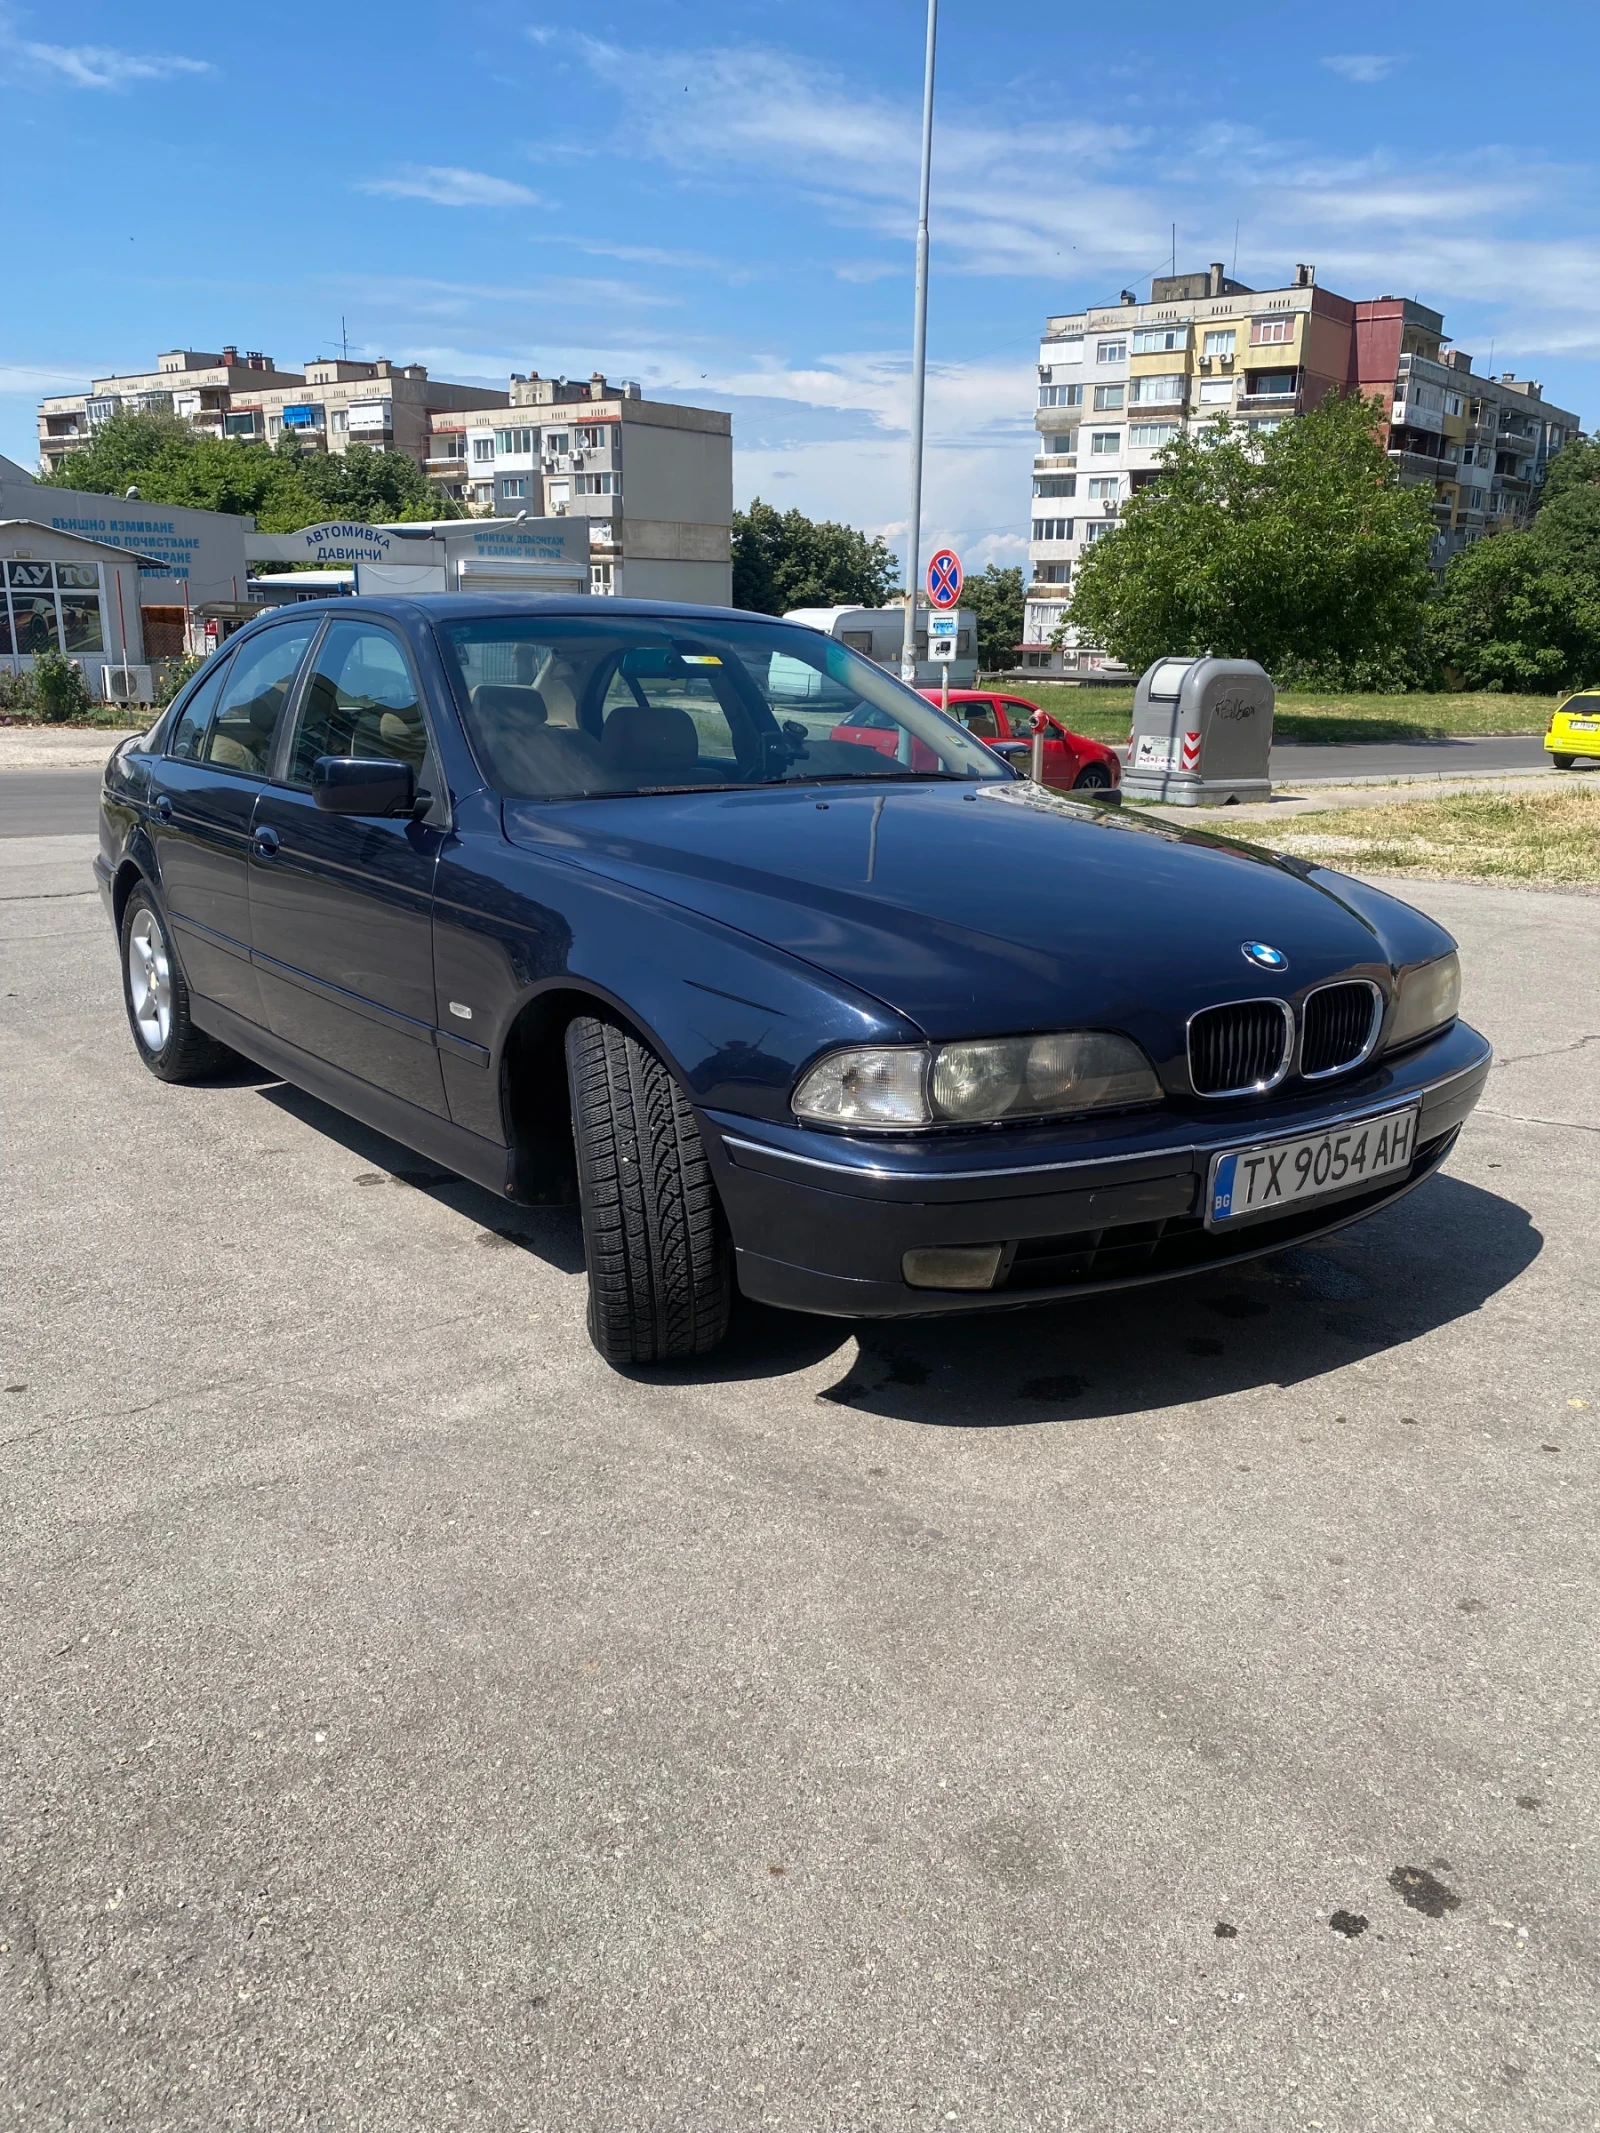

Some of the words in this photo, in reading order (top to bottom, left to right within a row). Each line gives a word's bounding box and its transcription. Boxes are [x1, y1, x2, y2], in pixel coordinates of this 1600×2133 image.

[52, 517, 106, 531] ВЪНШНО
[110, 520, 175, 534] ИЗМИВАНЕ
[124, 536, 200, 549] ПОЧИСТВАНЕ
[305, 525, 390, 549] АВТОМИВКА
[474, 533, 514, 544] МОНТАЖ
[516, 535, 565, 546] ДЕМОНТАЖ
[317, 547, 382, 561] ДАВИНЧИ
[487, 546, 522, 557] БАЛАНС
[524, 547, 537, 558] НА
[1243, 1151, 1288, 1204] TX
[1295, 1130, 1370, 1192] 9054
[1371, 1117, 1412, 1170] AH
[1214, 1194, 1231, 1211] BG
